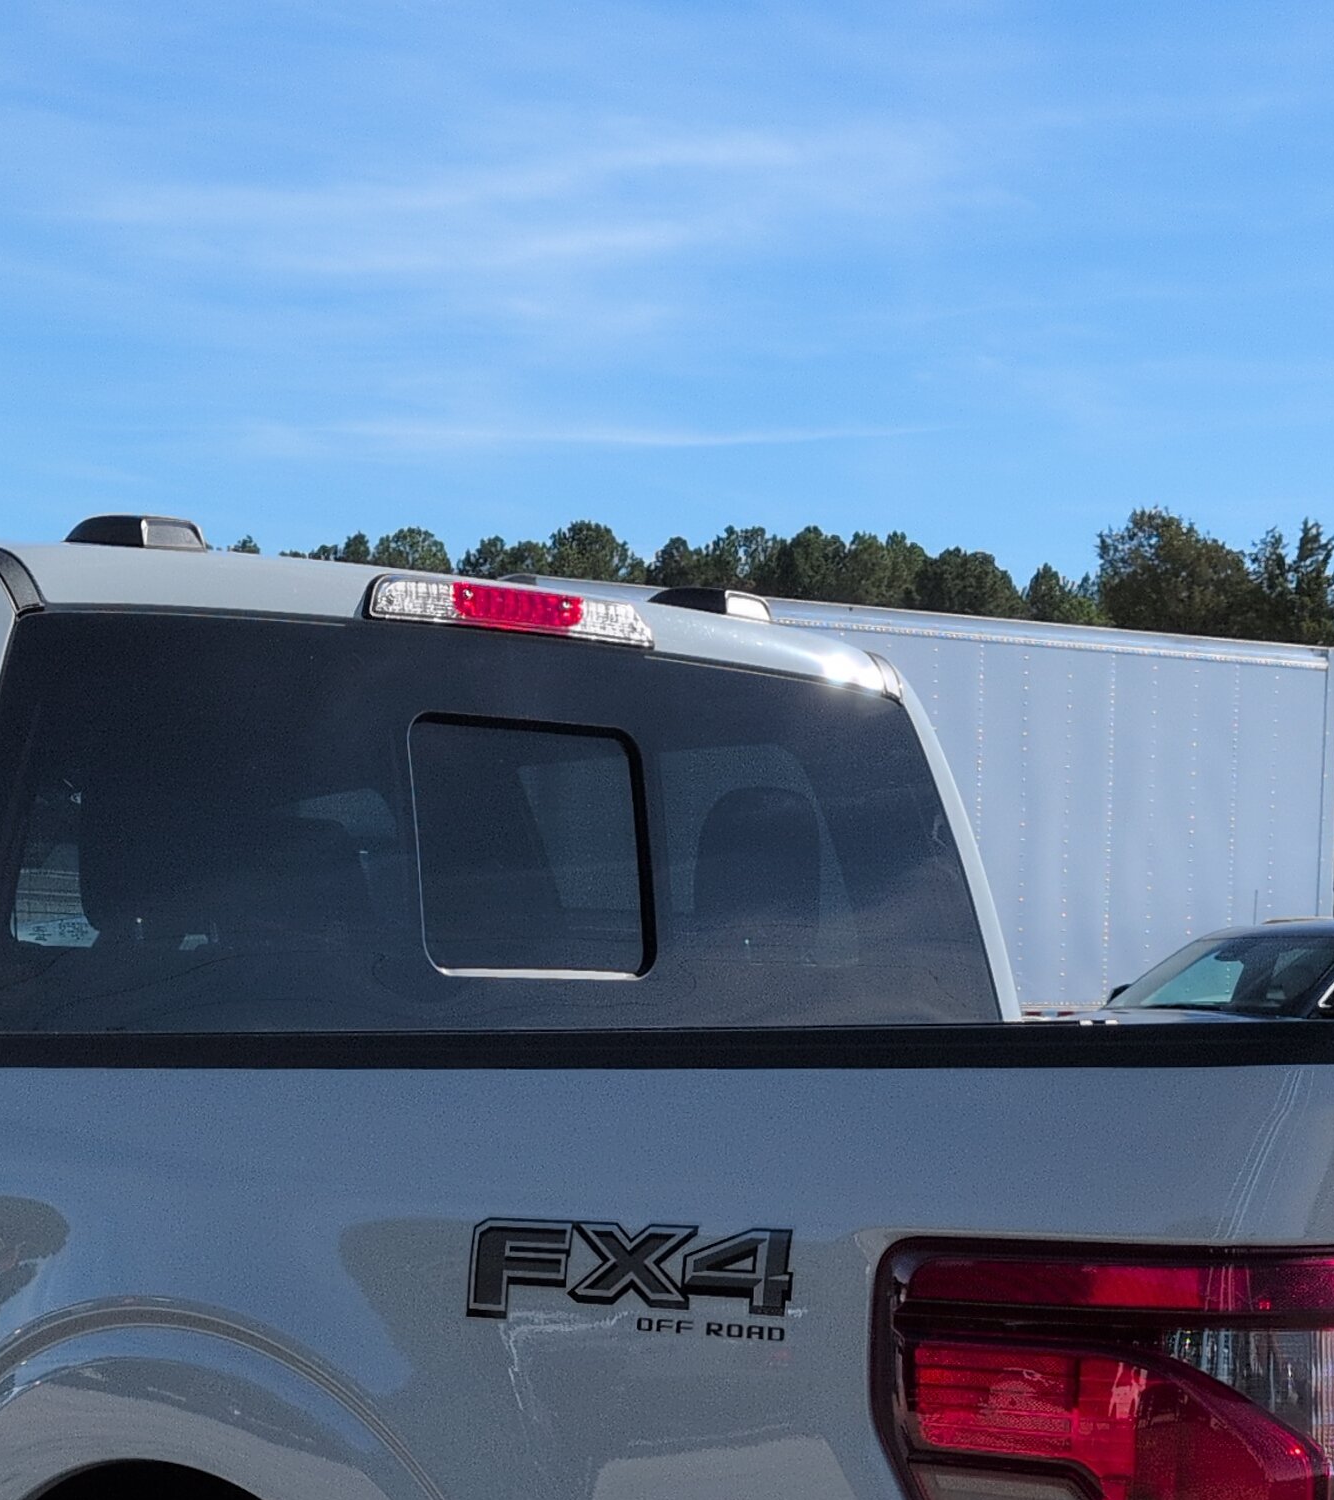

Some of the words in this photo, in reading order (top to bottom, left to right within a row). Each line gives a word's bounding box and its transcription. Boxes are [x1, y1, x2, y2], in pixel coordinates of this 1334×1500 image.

[466, 1217, 794, 1319] FX4
[636, 1317, 694, 1335] OFF
[705, 1320, 786, 1342] ROAD
